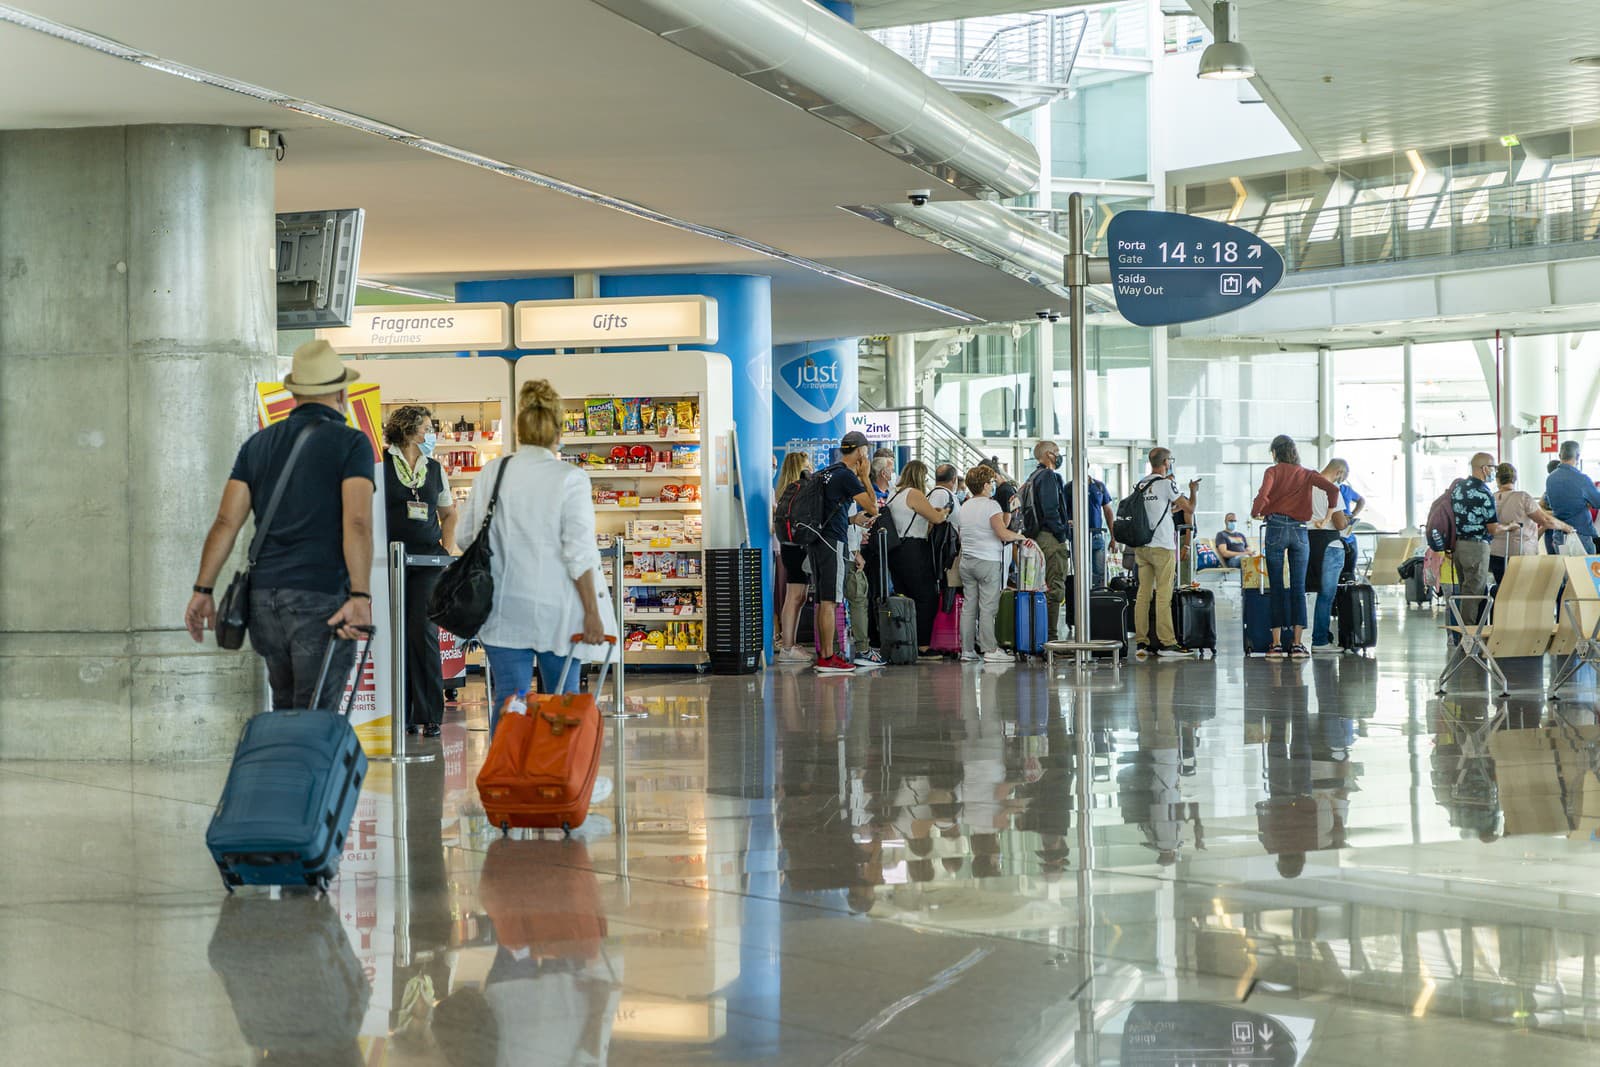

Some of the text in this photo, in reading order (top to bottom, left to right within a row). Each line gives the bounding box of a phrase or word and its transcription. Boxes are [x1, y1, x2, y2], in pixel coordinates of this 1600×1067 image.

[1118, 240, 1239, 263] Porta 14 a 18
[1118, 254, 1205, 264] Gate to
[1118, 273, 1146, 283] Saída
[1118, 285, 1164, 297] Way Out
[371, 316, 455, 333] Fragrances
[593, 313, 628, 331] Gifts
[371, 332, 421, 345] Perfumes
[795, 360, 838, 389] just
[852, 415, 867, 425] Wi
[866, 422, 890, 433] Zink
